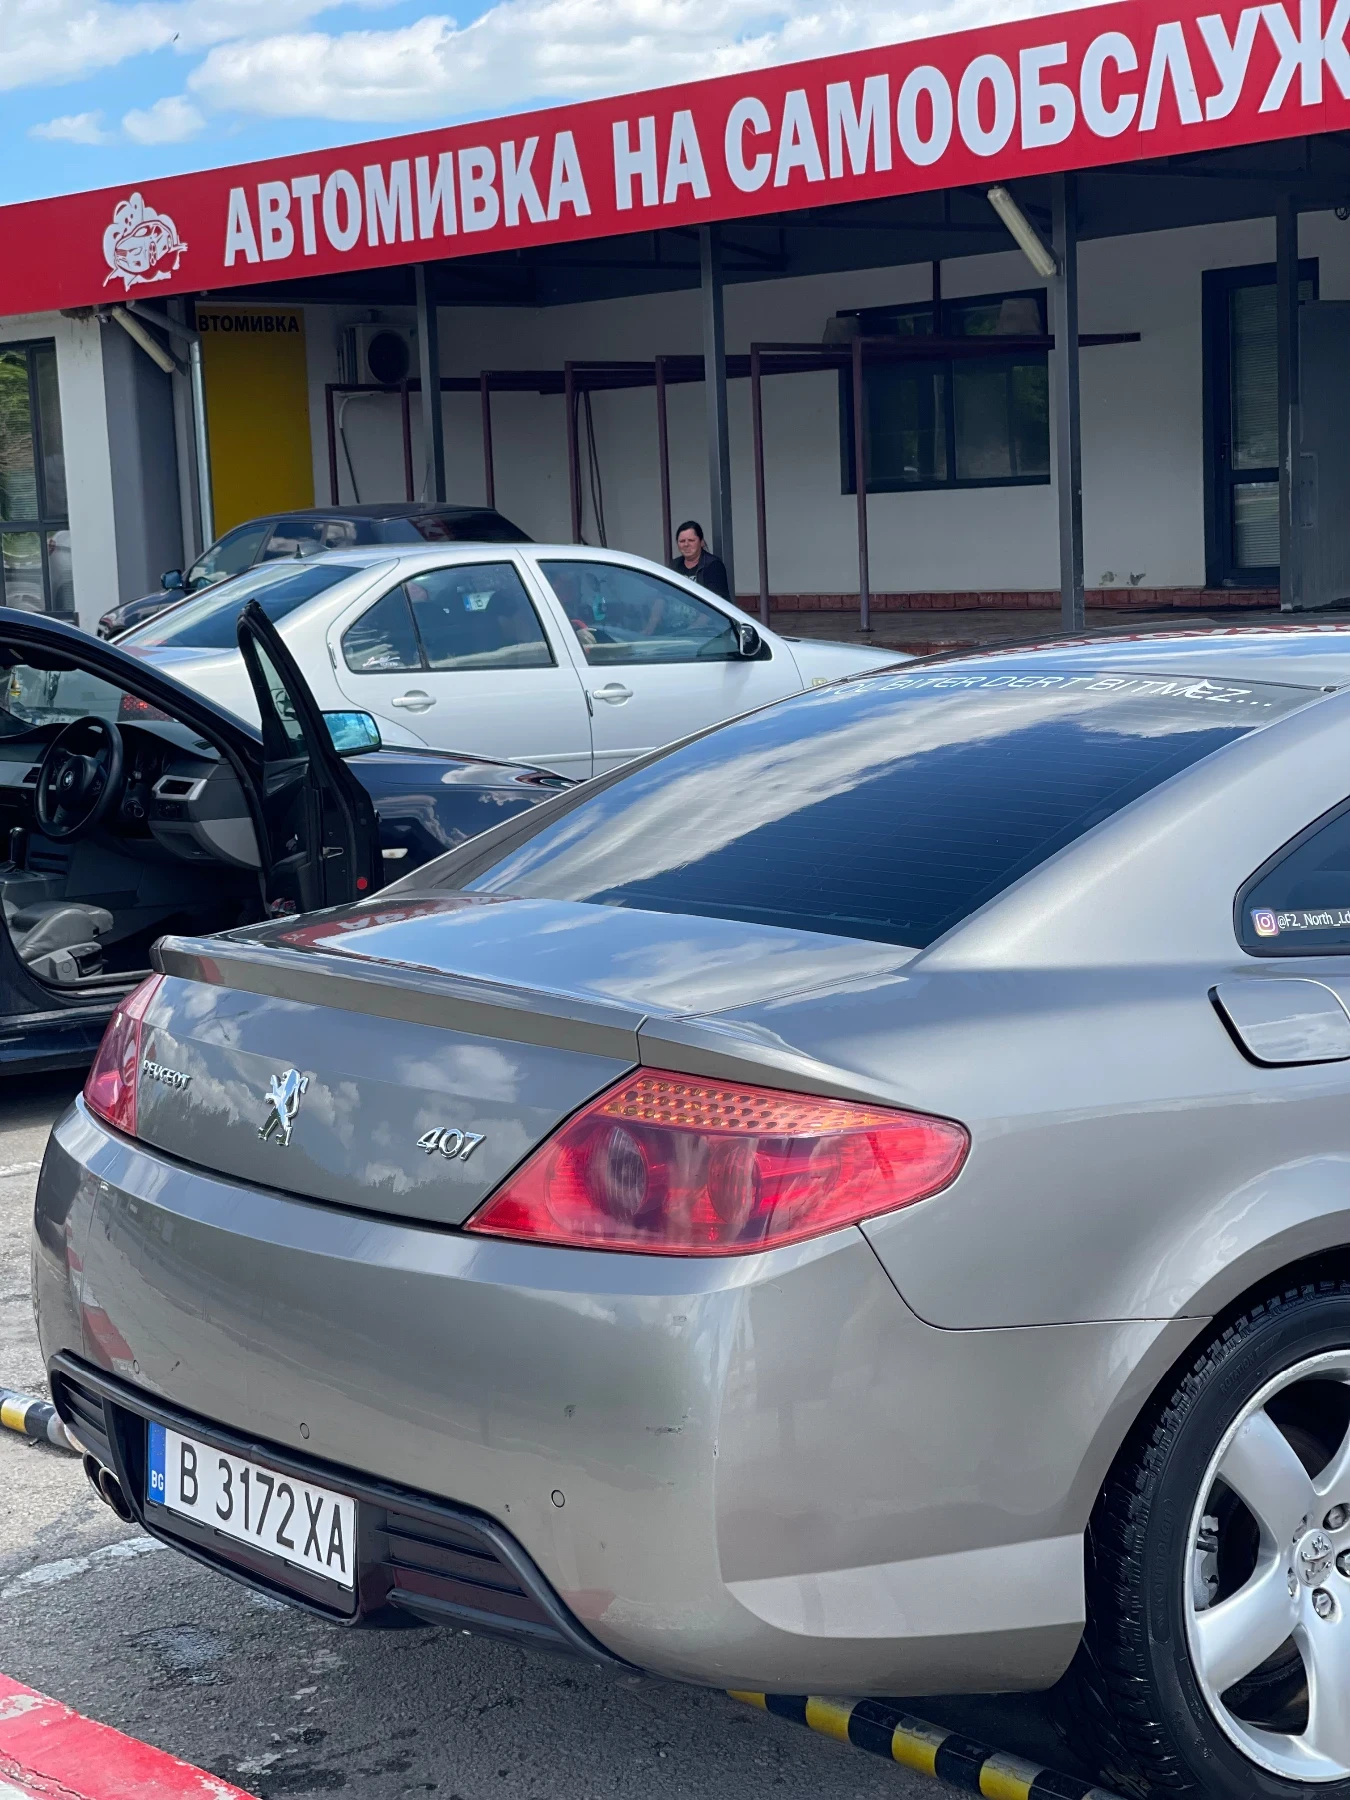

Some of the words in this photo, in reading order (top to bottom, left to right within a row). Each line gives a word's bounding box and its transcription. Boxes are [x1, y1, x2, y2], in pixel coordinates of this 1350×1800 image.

[224, 131, 591, 267] АВТОМИВКА
[612, 109, 711, 211] НА
[724, 0, 1350, 193] САМООБСЛУЖ
[198, 314, 300, 332] ВТОМИВКА
[878, 676, 987, 691] BITER
[980, 676, 1093, 689] DERT
[143, 1060, 191, 1089] PEUGEOT
[416, 1126, 486, 1161] 407
[151, 1470, 164, 1491] BG
[180, 1441, 199, 1506] B
